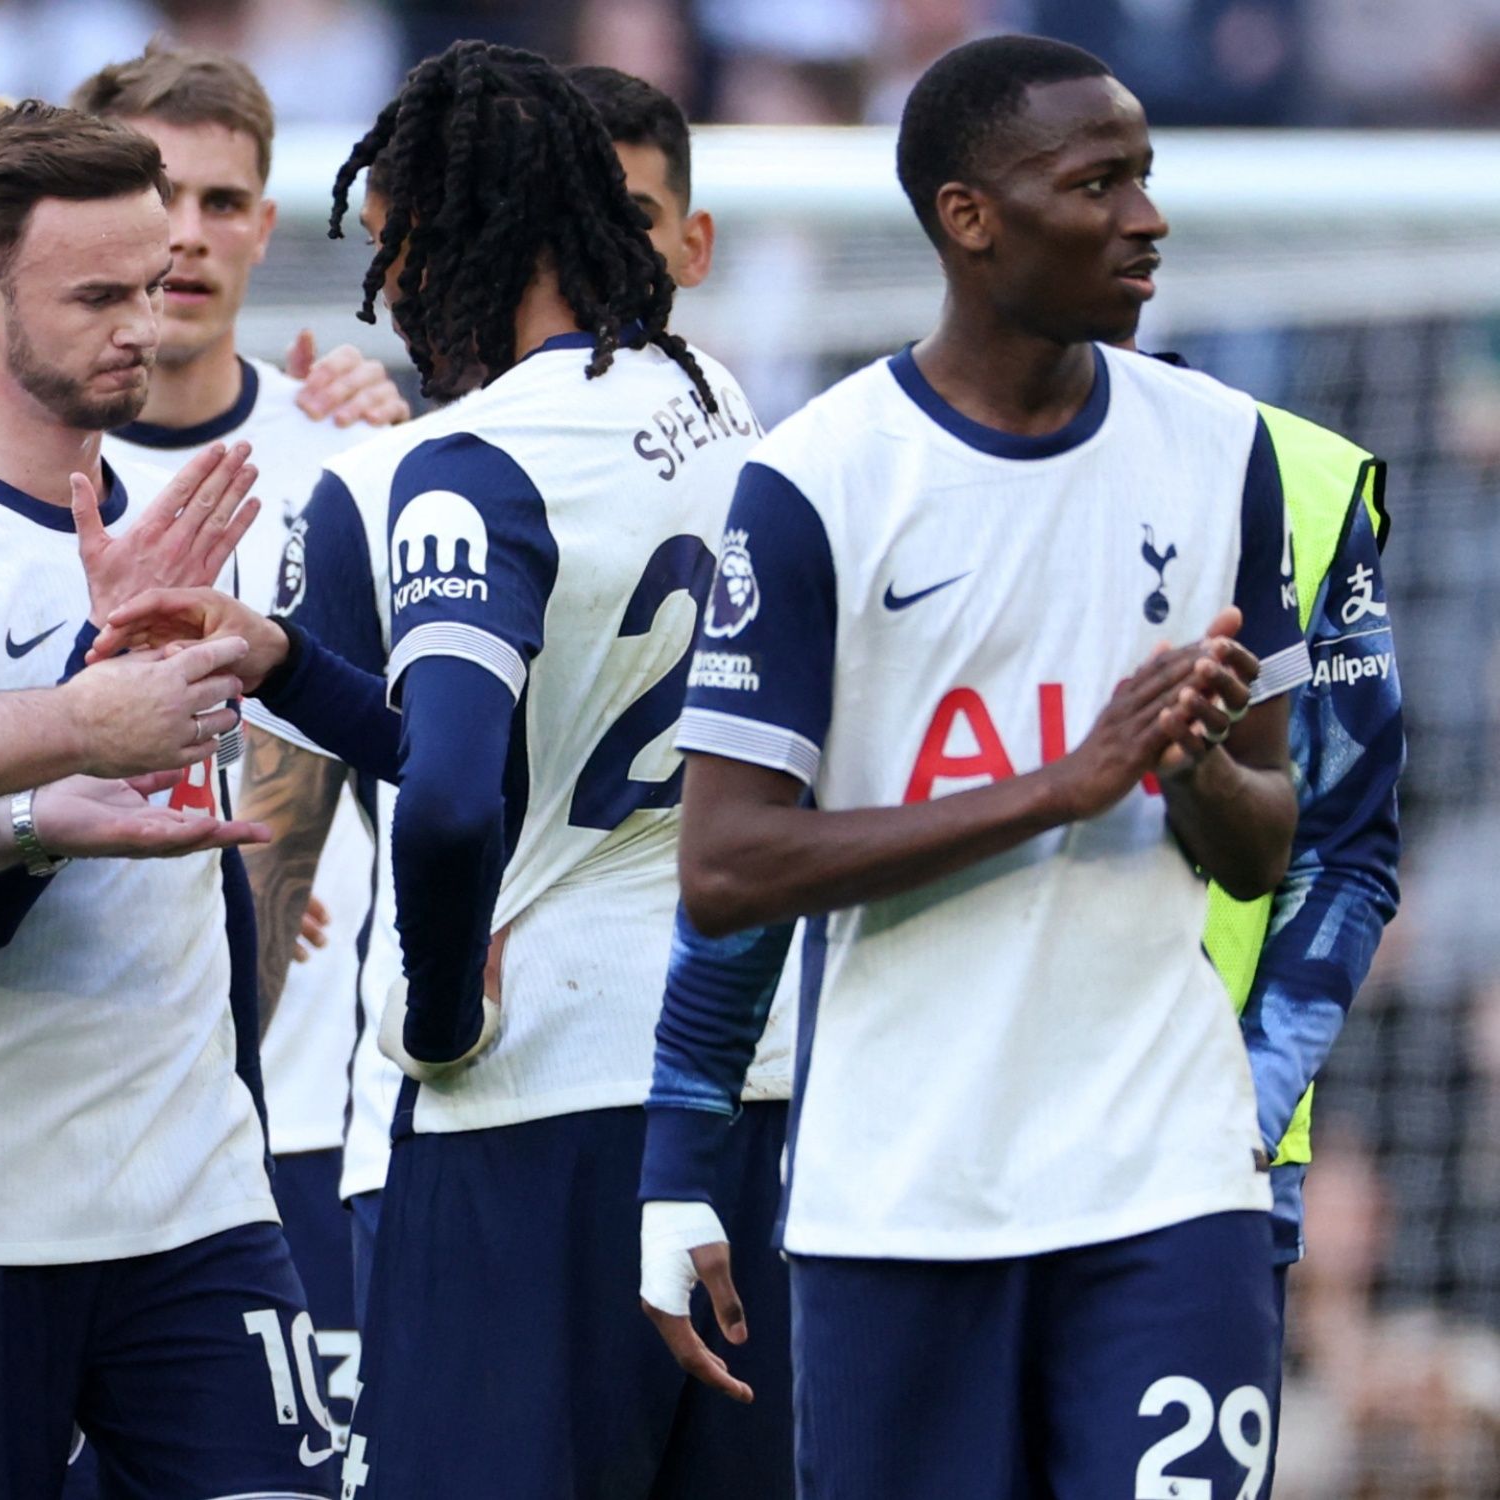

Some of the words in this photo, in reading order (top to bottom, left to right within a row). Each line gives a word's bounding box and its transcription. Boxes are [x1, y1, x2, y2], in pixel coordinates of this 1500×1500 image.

[633, 385, 763, 481] SPENC
[393, 576, 488, 615] kraken
[1312, 652, 1391, 687] Alipay
[902, 678, 1163, 805] AI
[1134, 1375, 1272, 1500] 29
